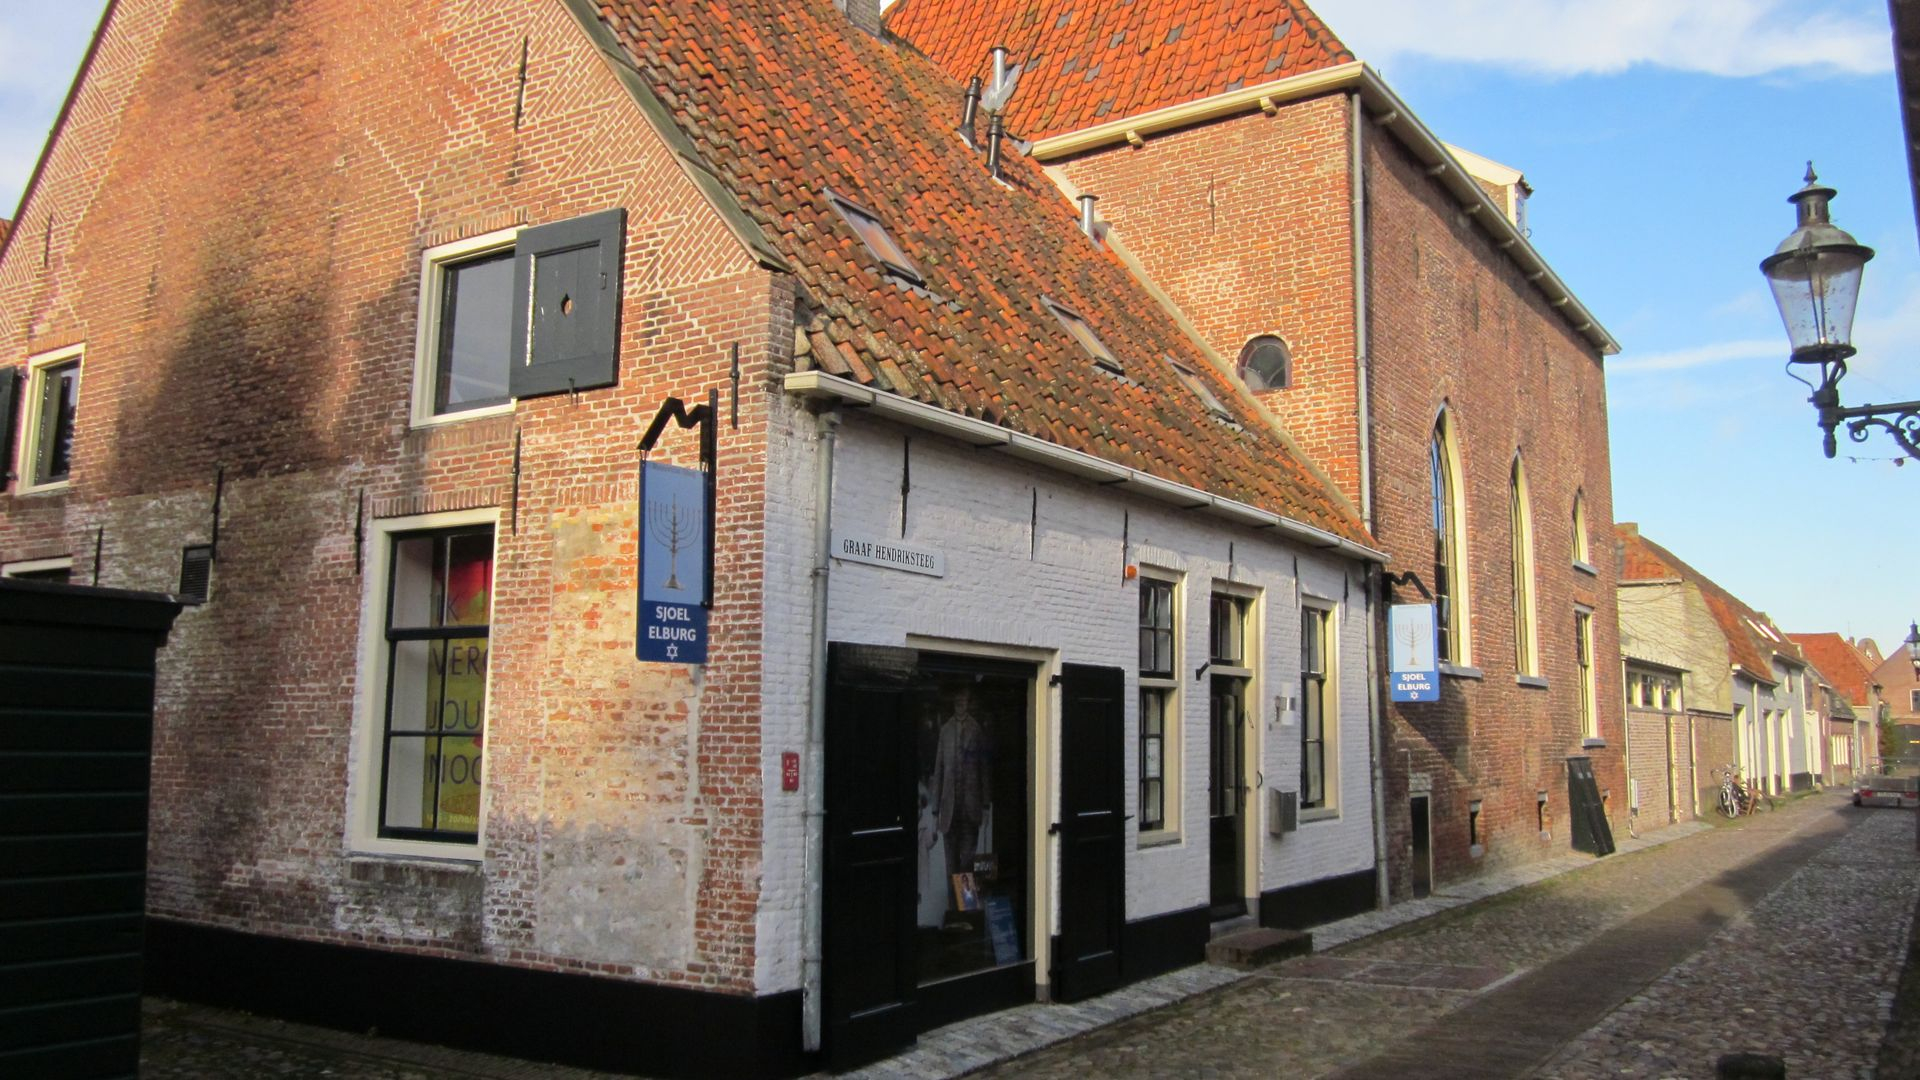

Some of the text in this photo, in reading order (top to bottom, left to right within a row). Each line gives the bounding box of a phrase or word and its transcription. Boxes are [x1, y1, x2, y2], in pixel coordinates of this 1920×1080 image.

[843, 539, 935, 569] GRAAF HENDRIKSTEEG
[656, 606, 691, 622] SJOEL
[648, 625, 697, 641] ELBURG
[1402, 673, 1426, 682] SJOEL
[1397, 683, 1431, 691] ELBURG
[429, 700, 480, 729] JOU
